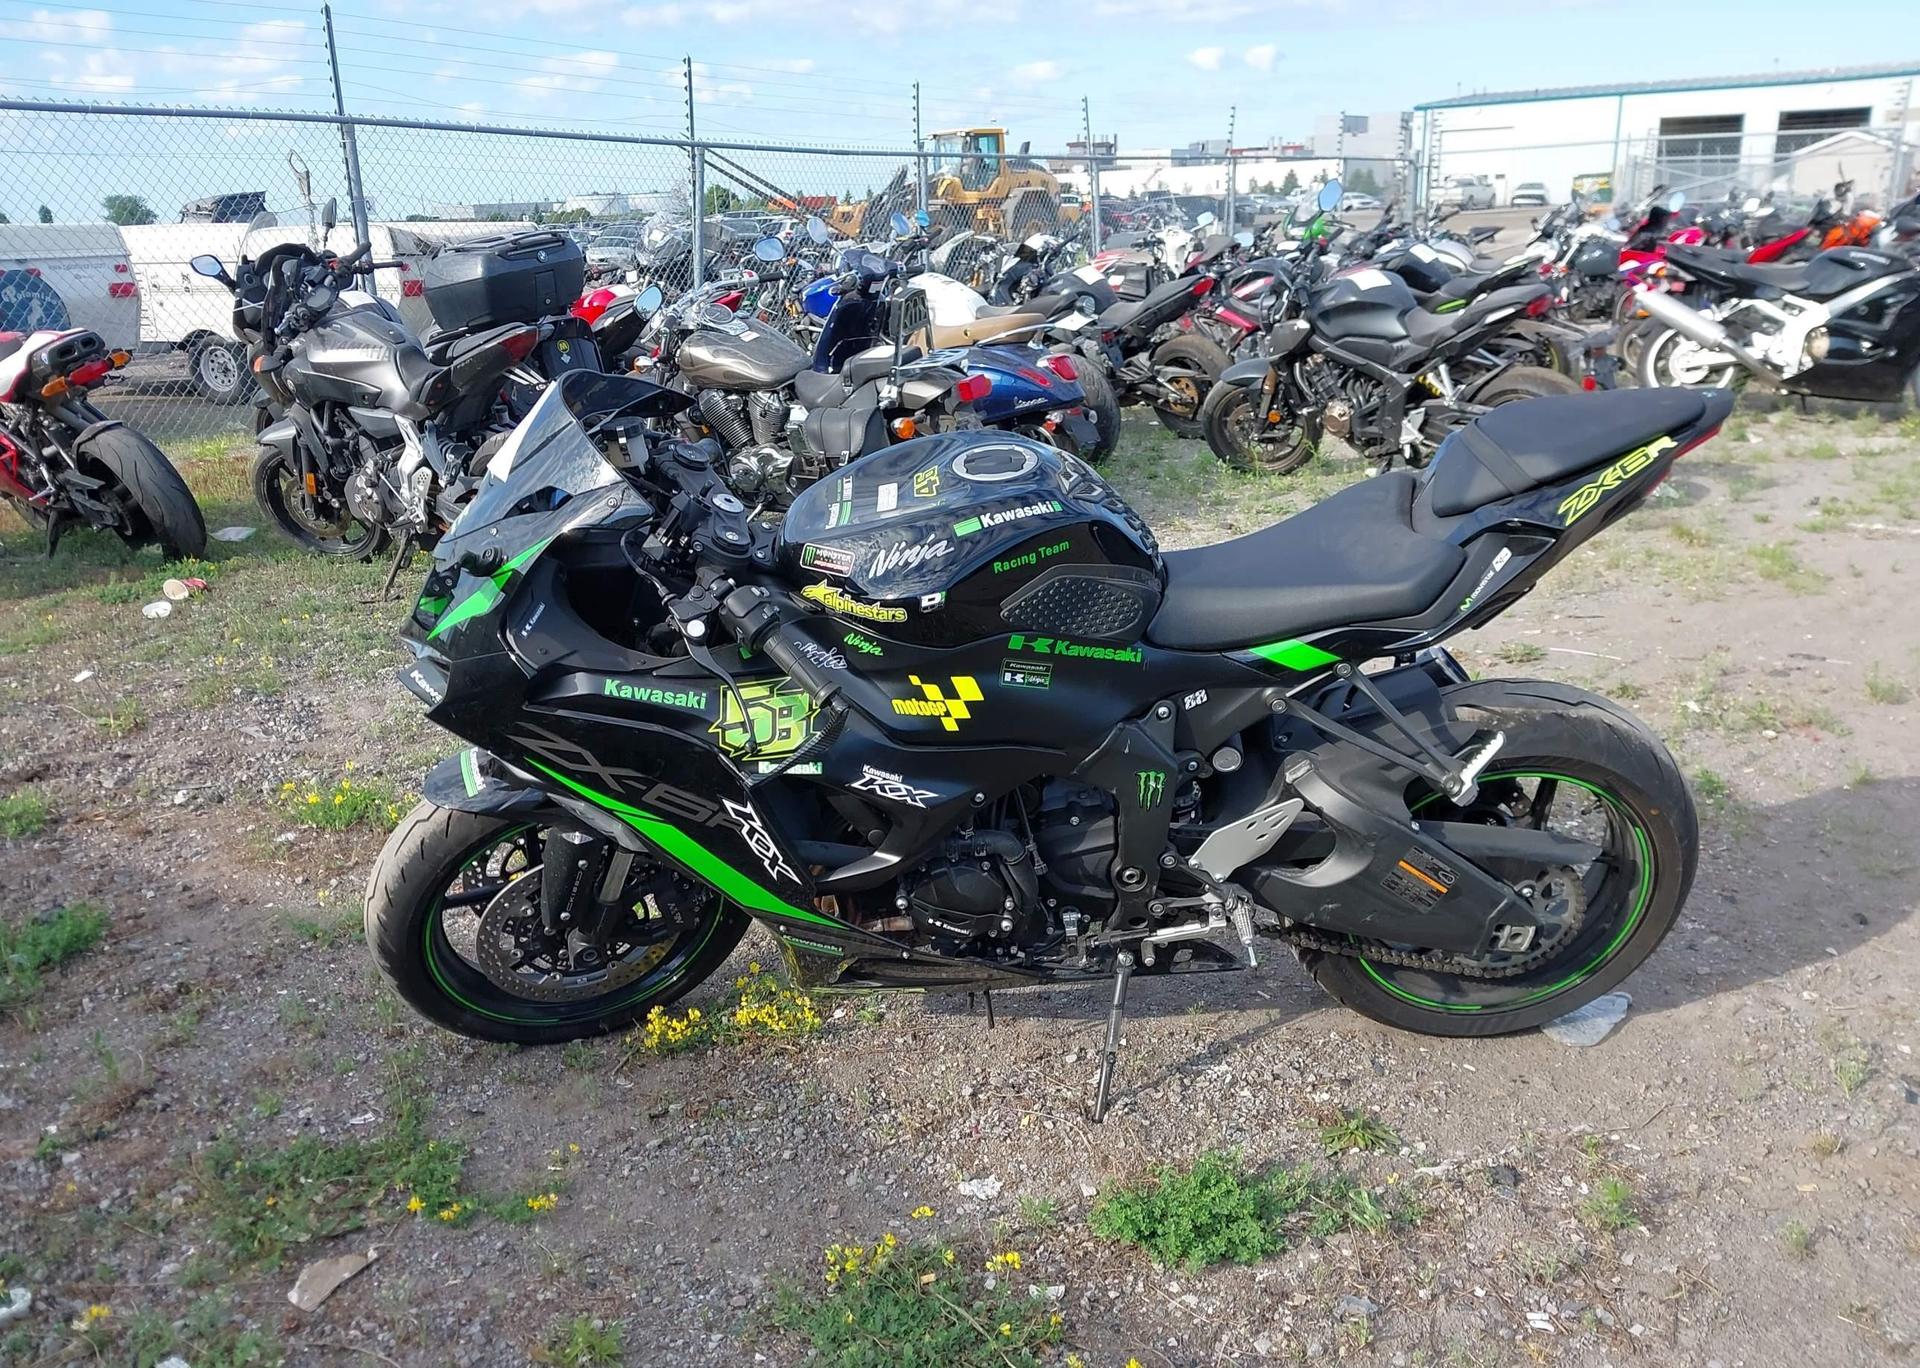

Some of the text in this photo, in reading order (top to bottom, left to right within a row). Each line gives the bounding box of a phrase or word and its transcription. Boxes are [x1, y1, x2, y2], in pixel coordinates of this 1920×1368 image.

[980, 501, 1055, 528] Kawasaki
[869, 534, 955, 579] Ninja
[993, 541, 1070, 575] Racing Team
[824, 592, 906, 622] alpinestars
[843, 633, 884, 656] Ninja
[1055, 640, 1143, 663] Kawasaki
[604, 679, 706, 709] Kawasaki
[862, 764, 903, 782] Kawasaki
